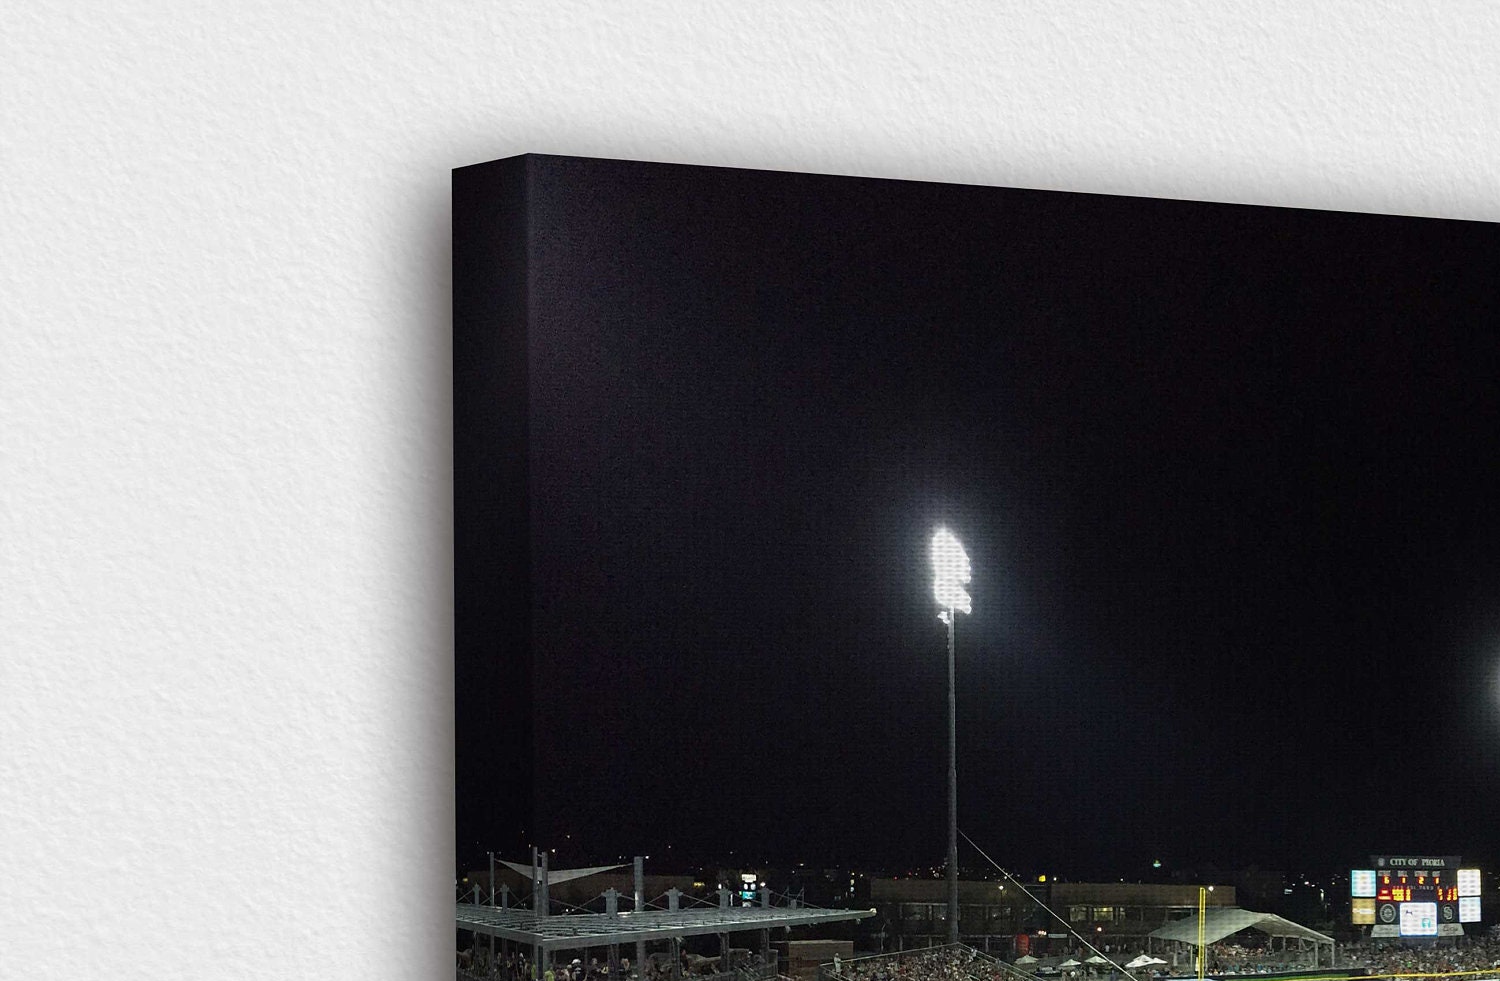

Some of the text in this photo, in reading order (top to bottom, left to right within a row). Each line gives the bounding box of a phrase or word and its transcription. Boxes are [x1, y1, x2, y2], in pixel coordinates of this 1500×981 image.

[1390, 858, 1445, 867] CITY OF PEORIA
